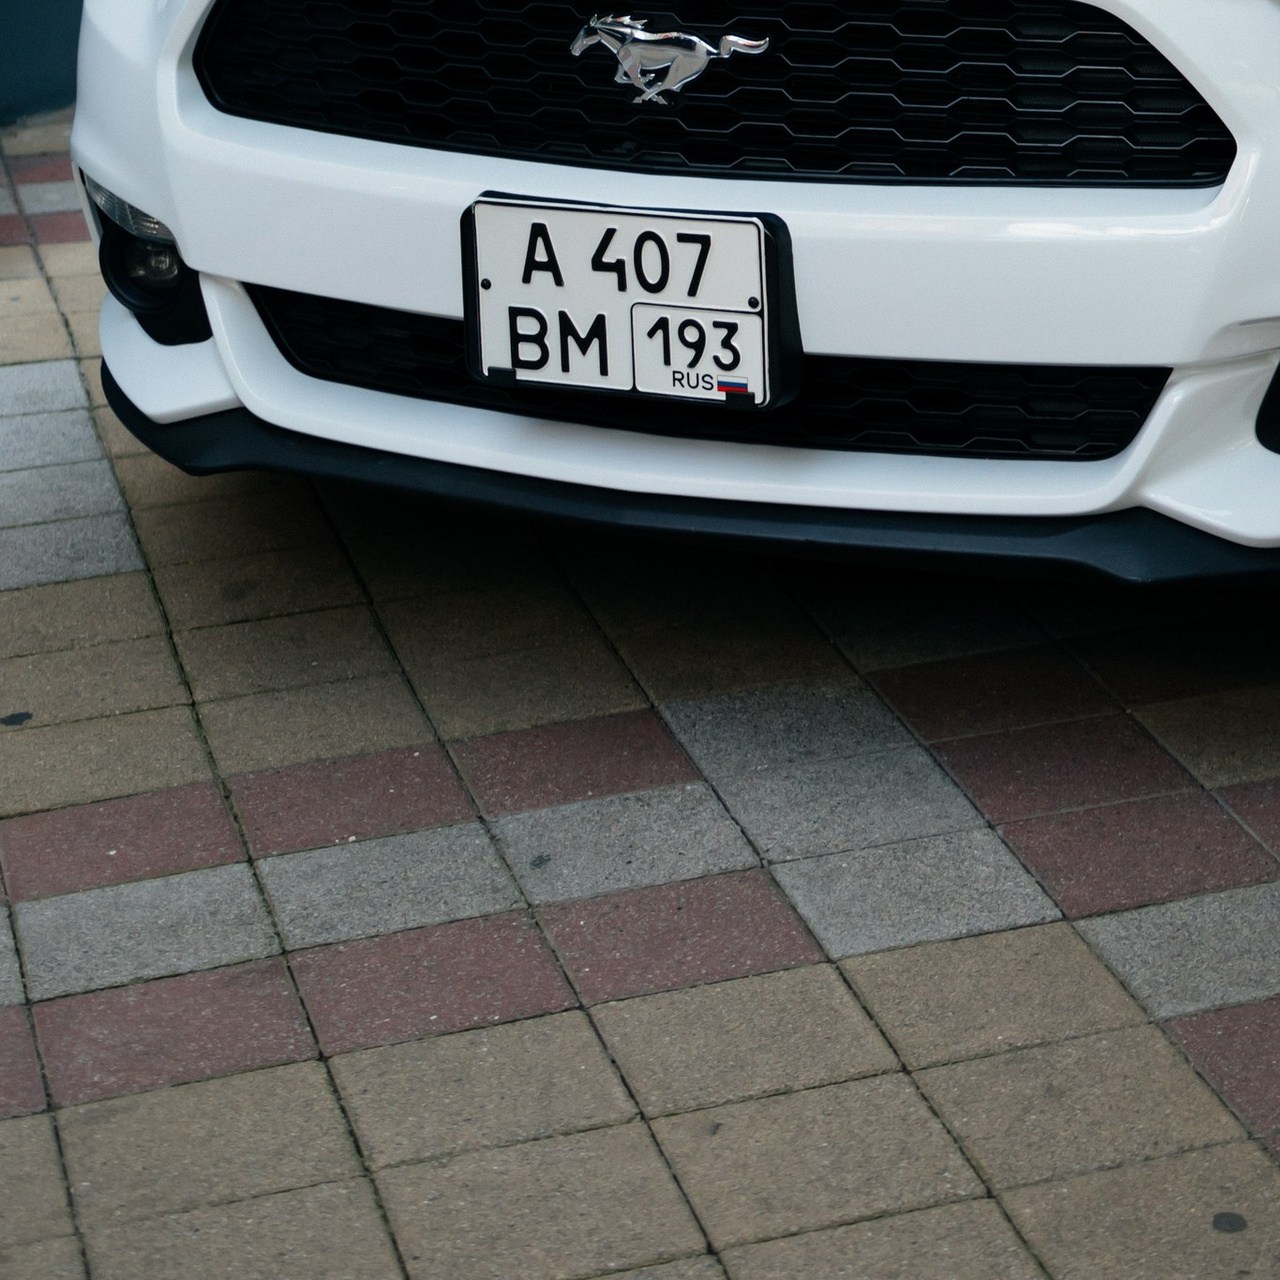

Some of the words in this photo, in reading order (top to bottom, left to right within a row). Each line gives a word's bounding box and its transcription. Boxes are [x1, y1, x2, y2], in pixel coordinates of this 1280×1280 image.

[591, 227, 711, 297] 407
[647, 316, 741, 371] 193
[672, 371, 714, 391] RUS
